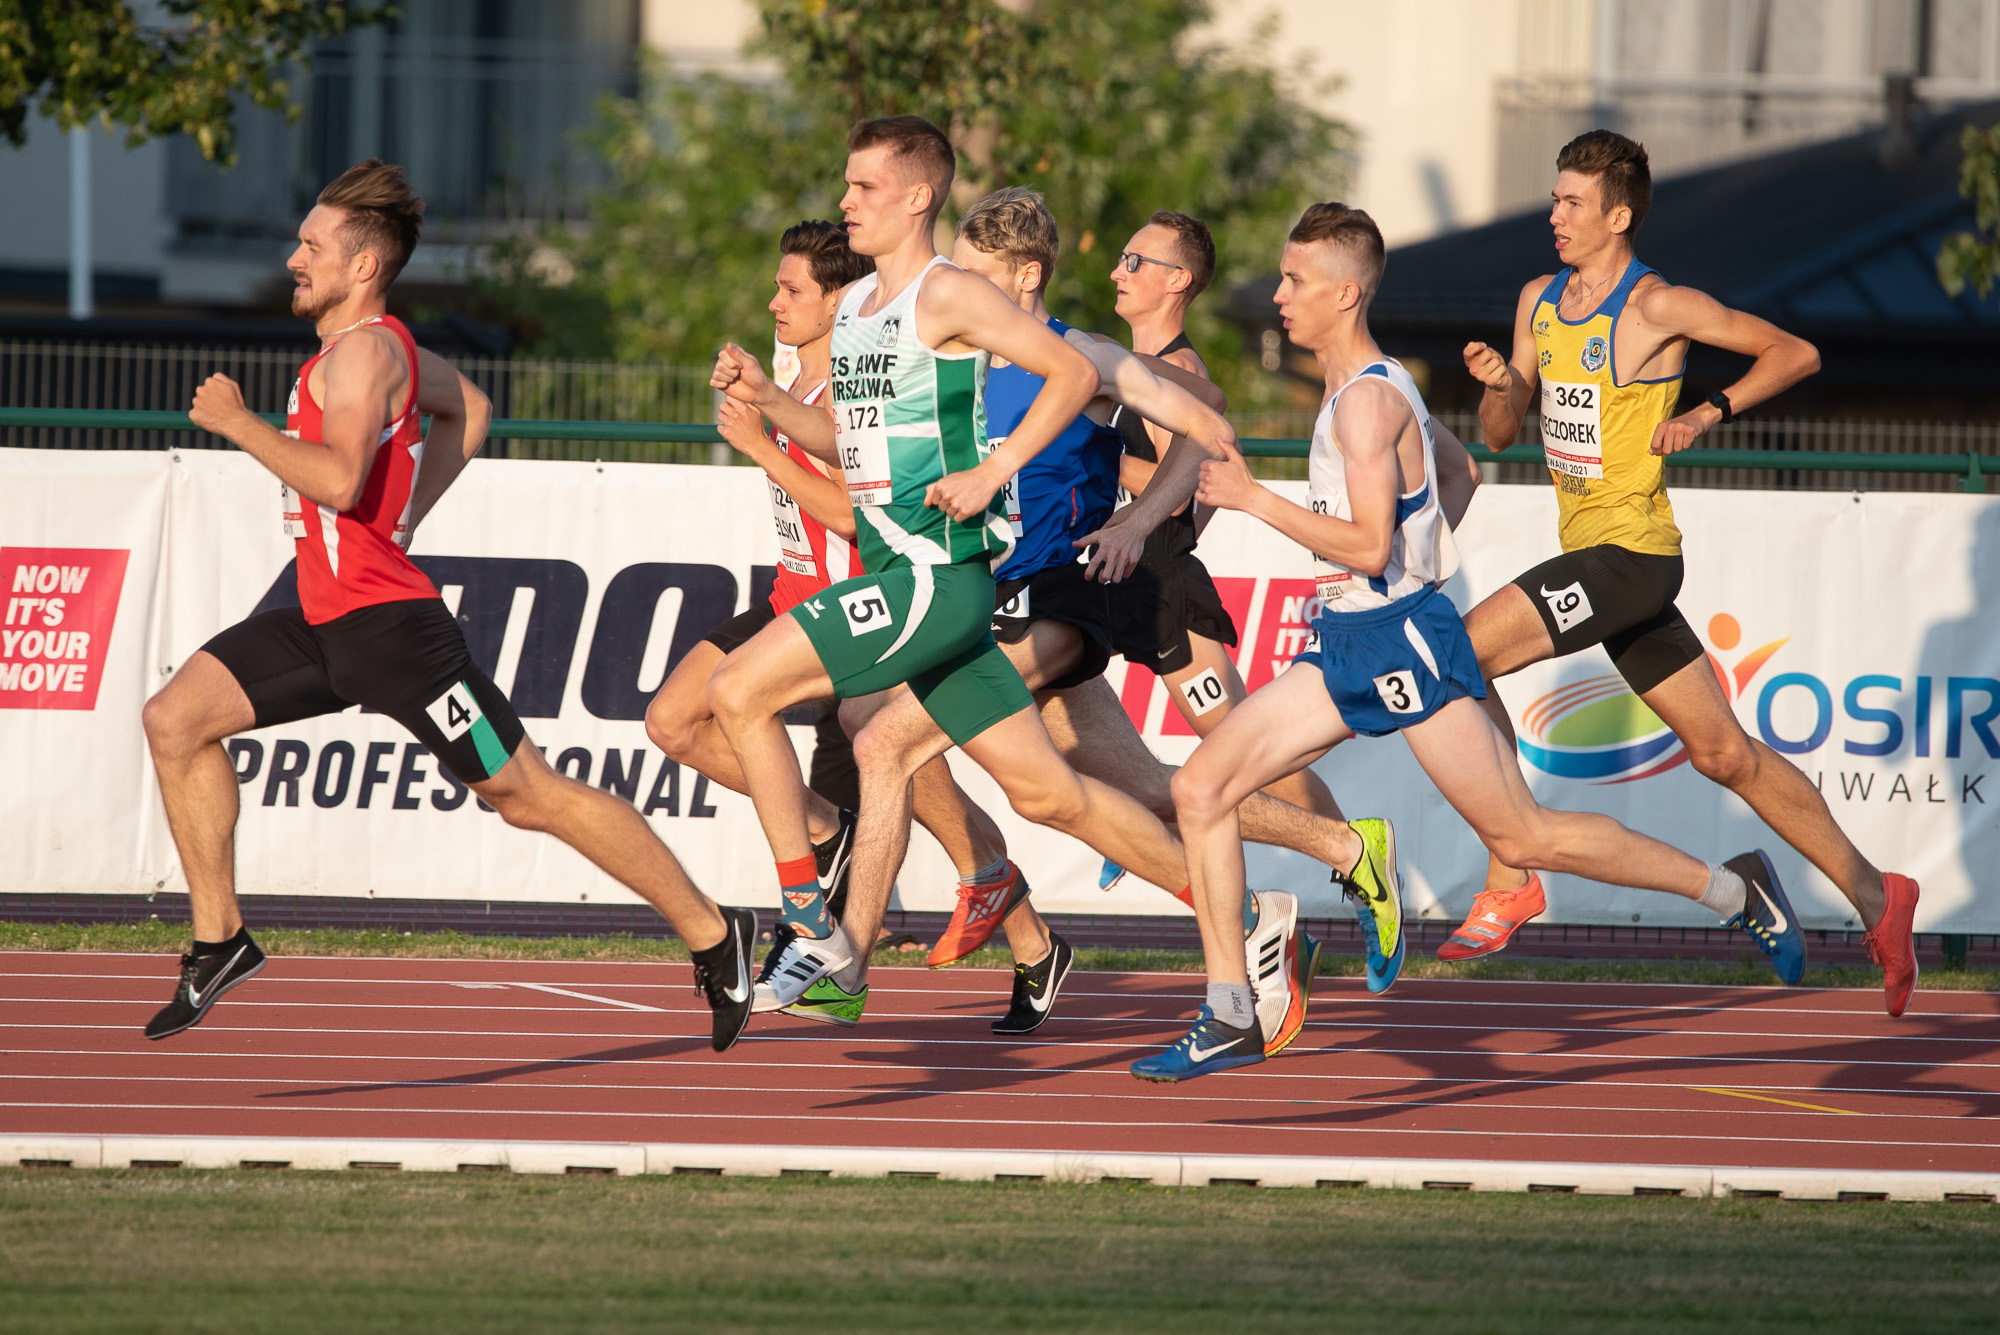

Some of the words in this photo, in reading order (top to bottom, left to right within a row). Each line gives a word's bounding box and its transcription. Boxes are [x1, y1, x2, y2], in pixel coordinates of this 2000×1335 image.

[831, 356, 849, 377] ZS
[855, 353, 898, 376] AWF
[832, 378, 896, 401] RSZAWA
[1555, 386, 1594, 409] 362
[848, 405, 879, 430] 172
[1544, 416, 1597, 445] ECZOREK
[1569, 464, 1588, 476] 2021
[772, 486, 794, 509] 24
[12, 565, 91, 594] NOW
[5, 597, 66, 627] IT'S
[849, 598, 886, 624] 5
[1280, 595, 1324, 625] NO
[2, 630, 90, 660] YOUR
[0, 662, 88, 692] MOVE
[1187, 675, 1222, 709] 10
[1386, 675, 1411, 711] 3
[447, 693, 472, 728] 4
[1756, 672, 2000, 760] OSIR
[227, 738, 718, 819] PROFESONAL
[1231, 991, 1243, 1014] SPORT
